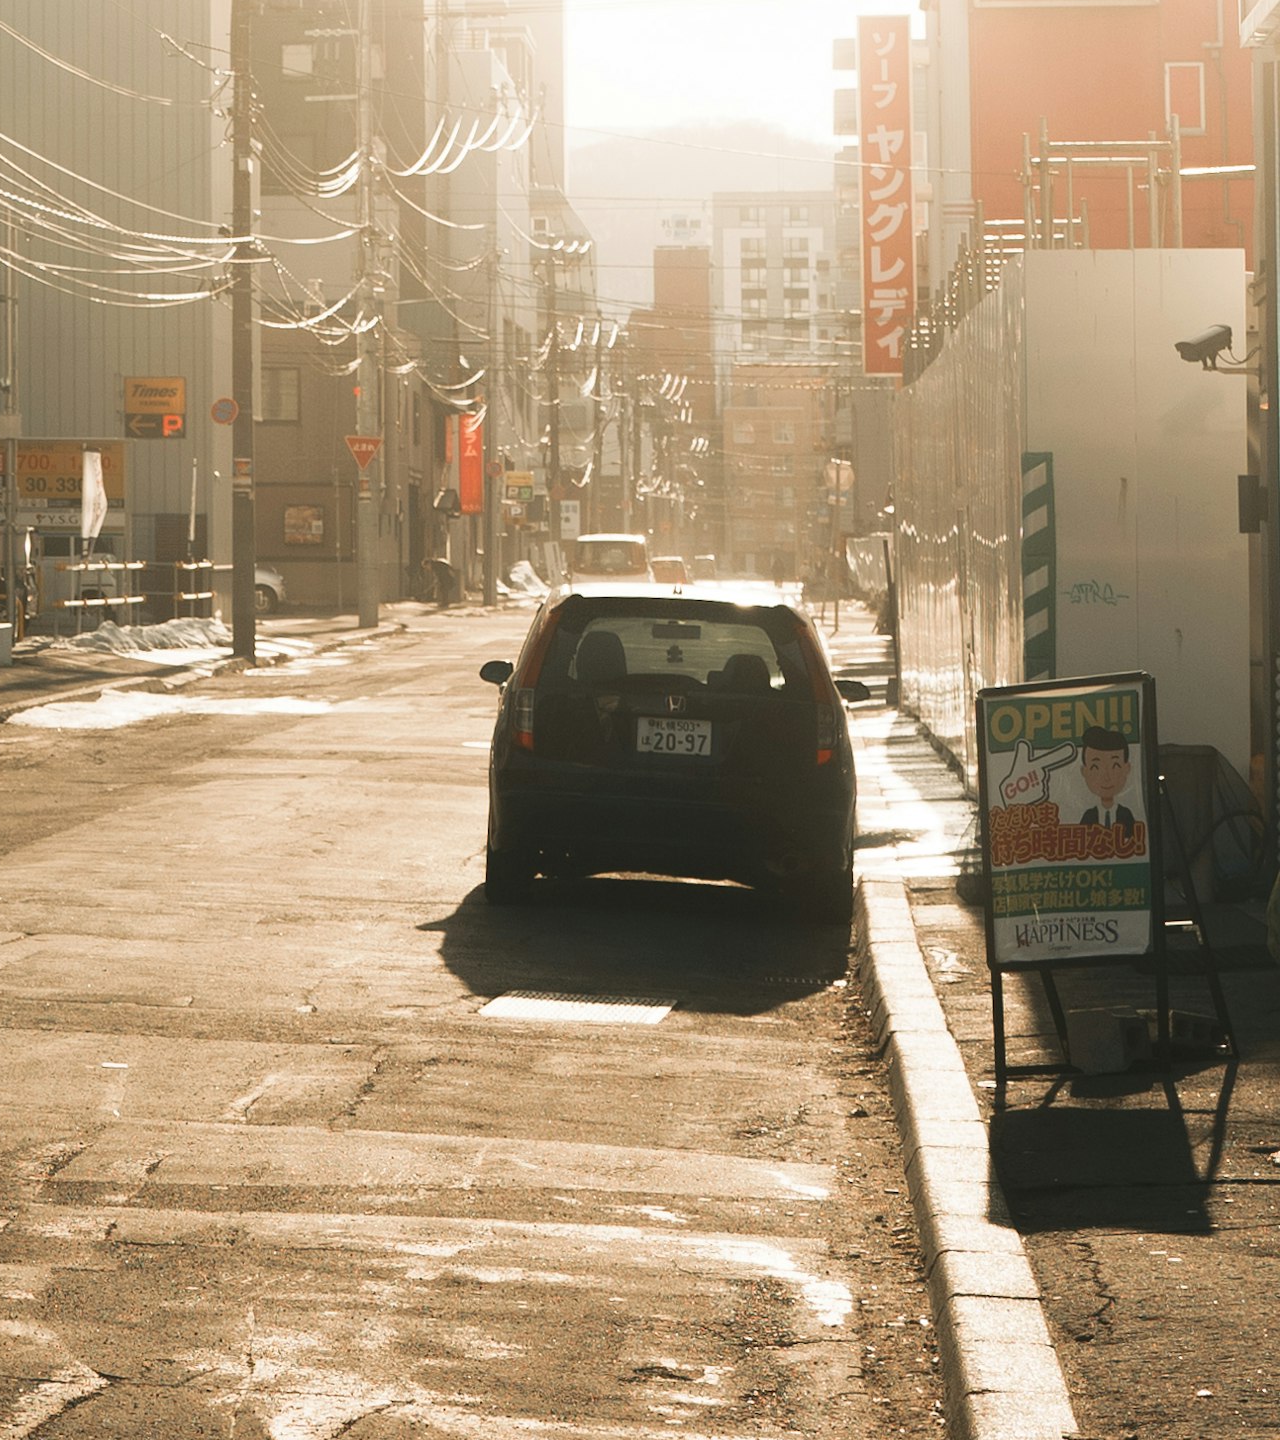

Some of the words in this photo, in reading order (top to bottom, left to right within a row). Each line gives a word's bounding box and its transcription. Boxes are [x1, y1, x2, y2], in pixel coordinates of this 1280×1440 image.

[871, 31, 898, 110] ソープ
[866, 124, 911, 360] ヤングレディ
[130, 384, 178, 398] Times
[162, 414, 184, 438] P
[990, 695, 1133, 743] OPEN!!
[653, 732, 708, 753] 20-97
[1004, 770, 1041, 800] GO!!
[990, 803, 1060, 832] ただいま
[990, 821, 1146, 866] 待ち時間なし!
